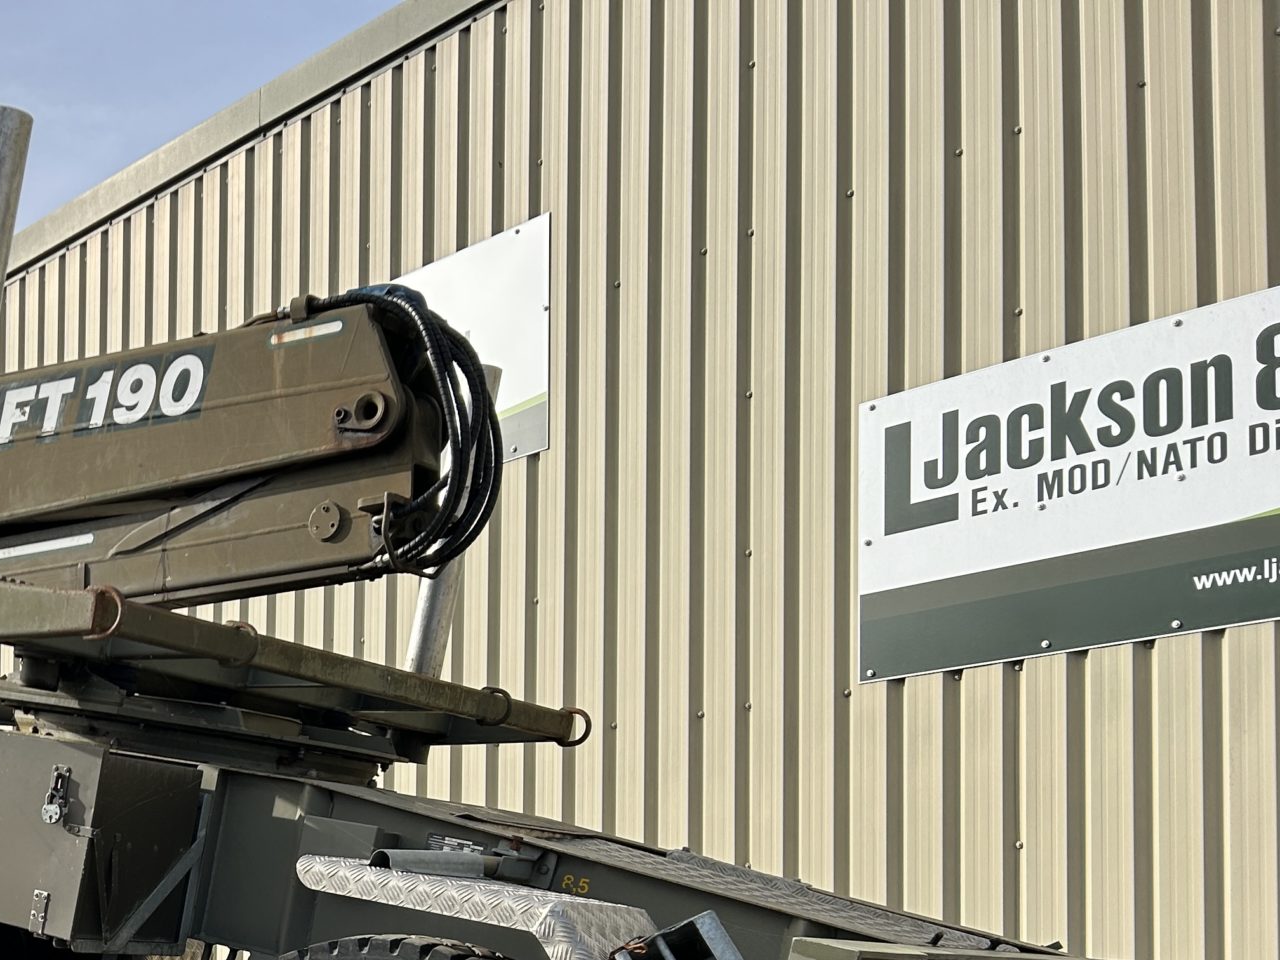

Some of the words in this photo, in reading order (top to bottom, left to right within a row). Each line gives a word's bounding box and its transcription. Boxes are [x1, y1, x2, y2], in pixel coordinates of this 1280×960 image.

[86, 354, 204, 428] 190
[971, 485, 1019, 517] Ex.
[1036, 431, 1228, 503] MOD/NATO
[1193, 557, 1280, 590] www.lj
